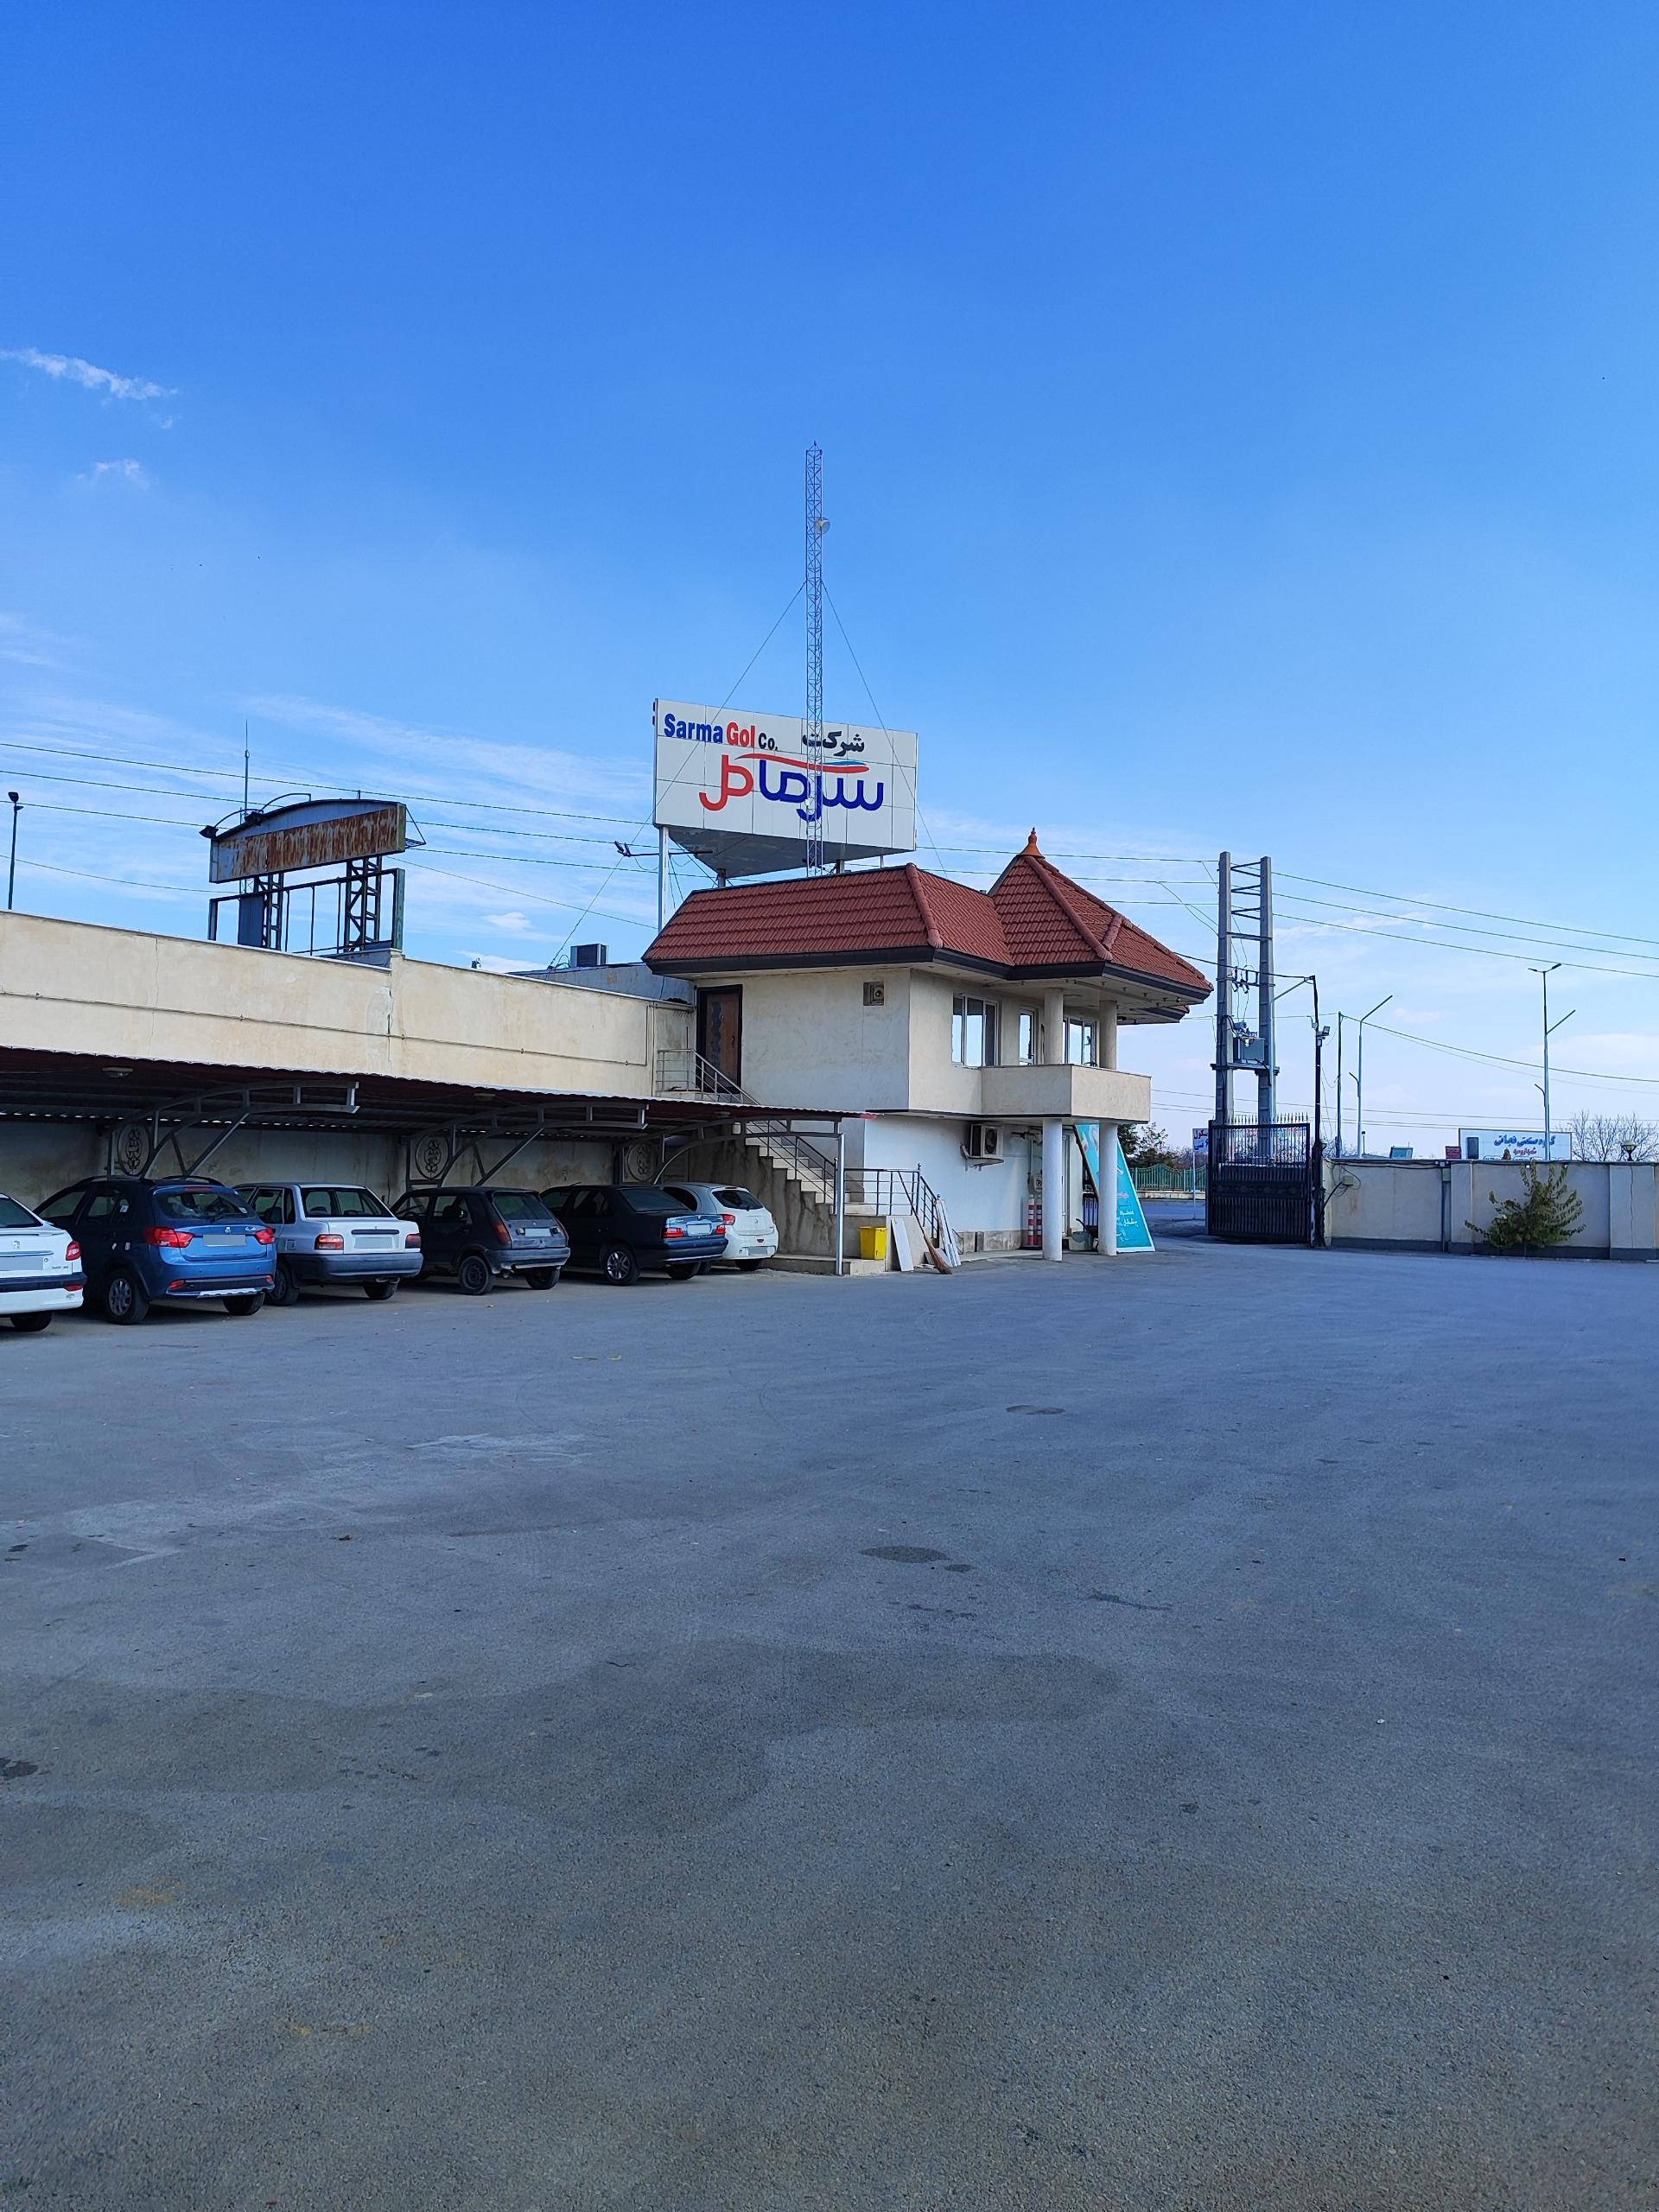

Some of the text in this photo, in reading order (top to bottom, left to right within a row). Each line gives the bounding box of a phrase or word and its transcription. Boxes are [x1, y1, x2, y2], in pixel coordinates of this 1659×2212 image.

[664, 713, 779, 751] Sarma Gol Co.
[802, 731, 865, 757] شرکت
